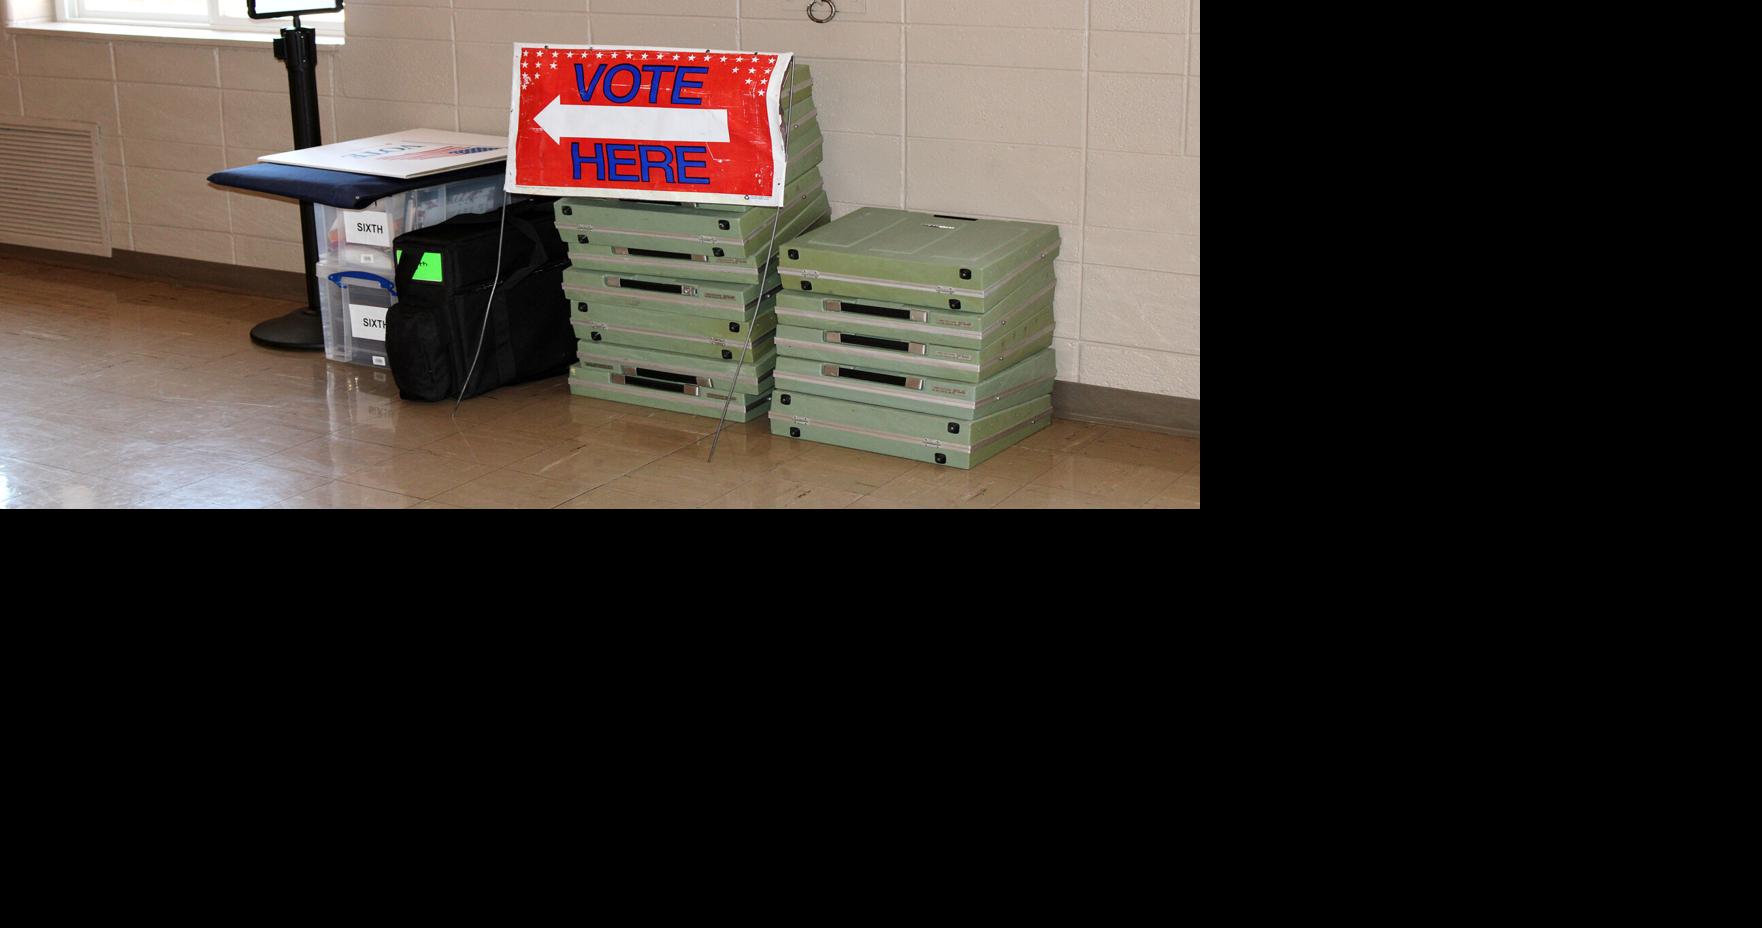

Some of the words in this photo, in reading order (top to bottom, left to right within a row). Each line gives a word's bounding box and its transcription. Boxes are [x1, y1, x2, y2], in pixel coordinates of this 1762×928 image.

[573, 62, 710, 106] VOTE
[570, 141, 711, 185] HERE
[356, 222, 384, 234] SIXTH
